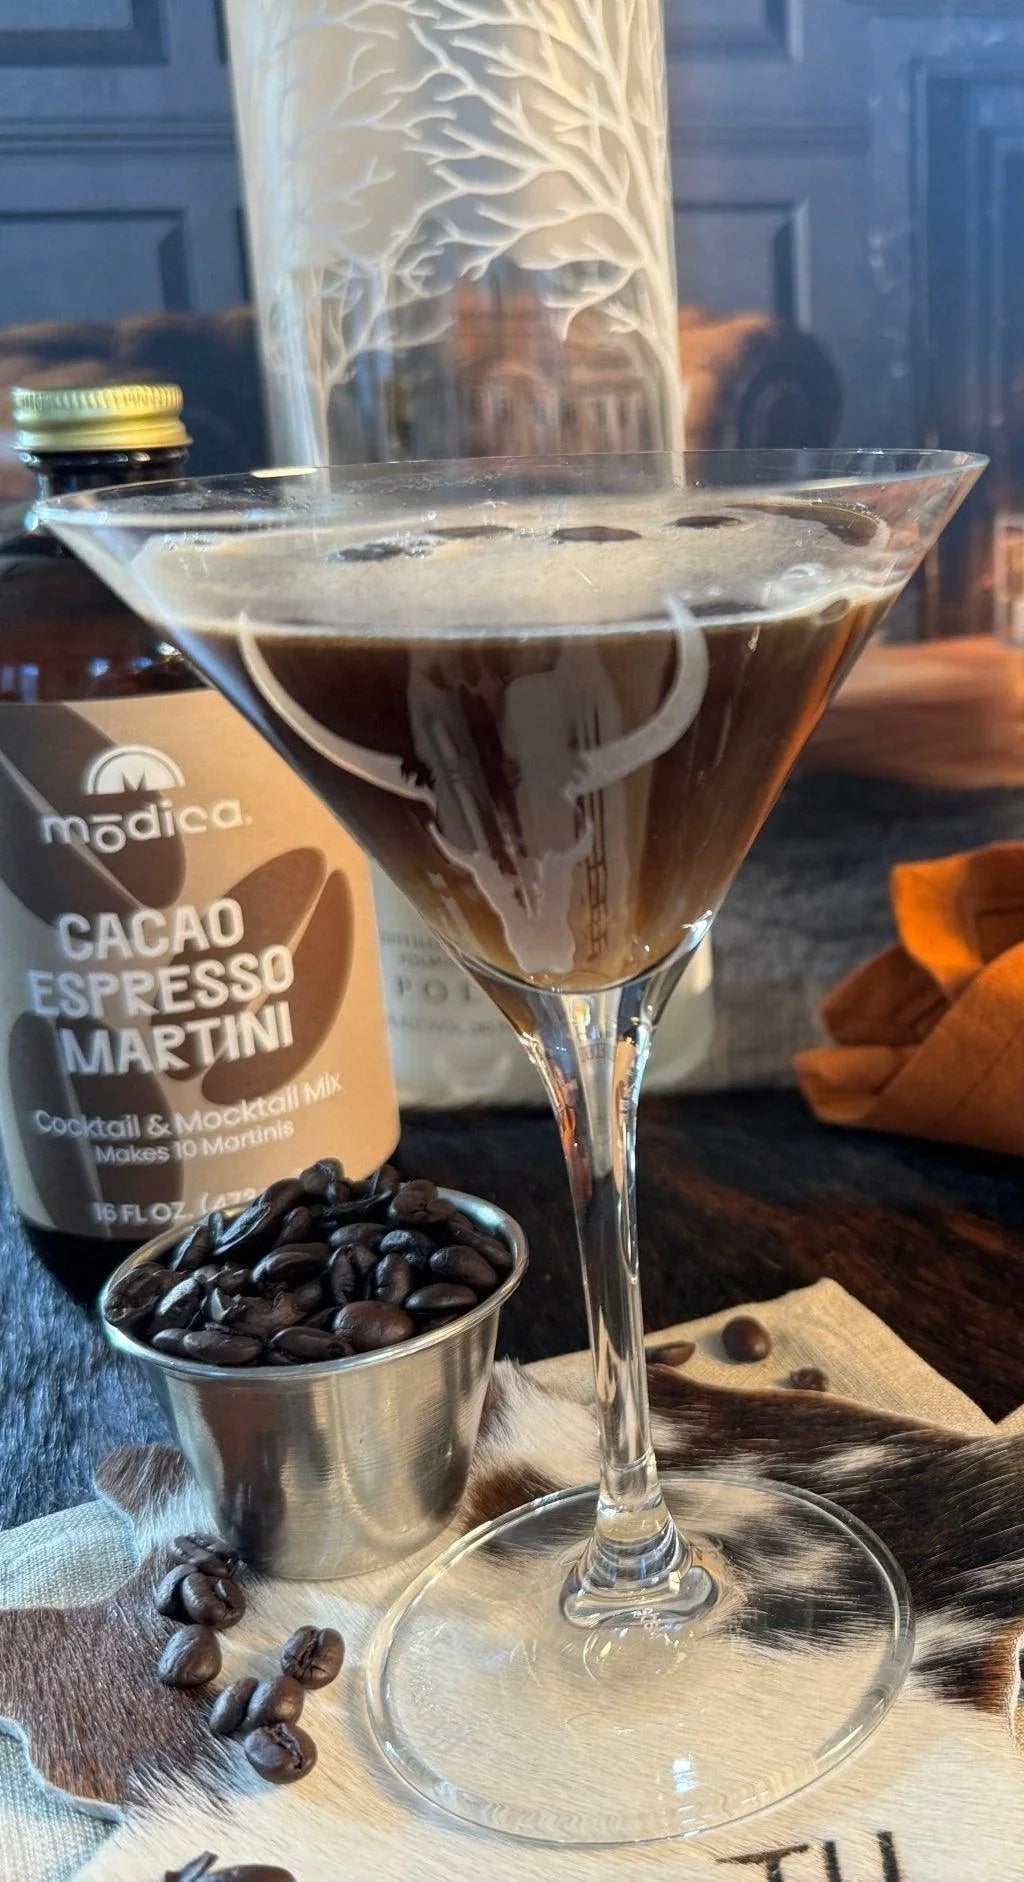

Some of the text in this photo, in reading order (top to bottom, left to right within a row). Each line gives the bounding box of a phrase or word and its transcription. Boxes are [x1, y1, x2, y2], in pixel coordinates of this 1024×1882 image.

[59, 898, 246, 961] CACAO
[28, 944, 296, 1018] ESPRESSO
[60, 1001, 294, 1077] MARTINI
[35, 1071, 343, 1141] Cocktail & Mocktail Mix
[94, 1118, 296, 1166] Makes 10 Martinis
[93, 1202, 118, 1225] 16
[121, 1203, 149, 1226] FL
